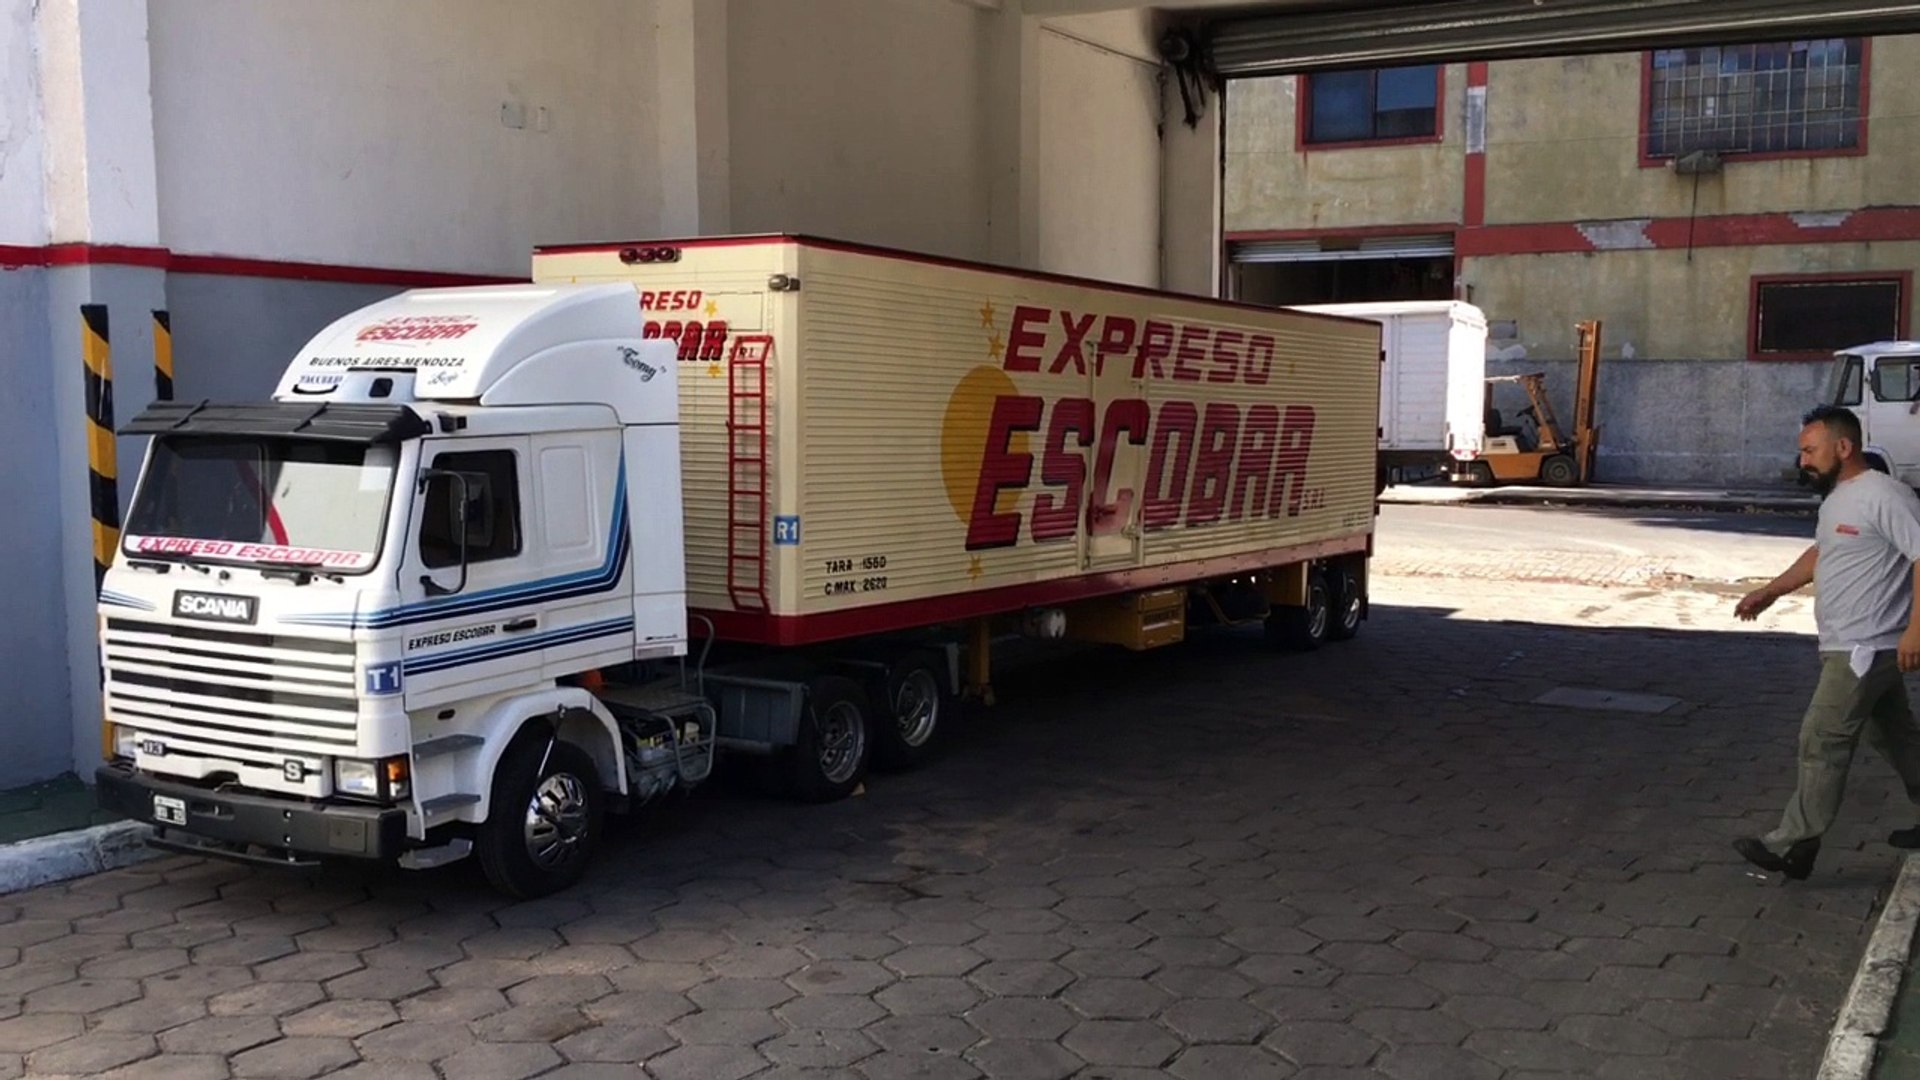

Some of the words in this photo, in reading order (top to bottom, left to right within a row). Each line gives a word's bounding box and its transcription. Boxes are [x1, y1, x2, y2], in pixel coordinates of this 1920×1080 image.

[356, 323, 478, 341] ESCOBAR
[1003, 304, 1275, 385] EXPRESO
[309, 356, 360, 367] BUENOS
[965, 394, 1315, 551] ESCOBAR
[777, 520, 798, 540] R1
[137, 536, 234, 555] EXPRESO
[236, 545, 362, 566] ESCOBAR
[825, 559, 853, 574] TARA
[178, 594, 249, 619] SCANIA
[408, 632, 452, 651] EXPRESO
[452, 624, 497, 642] ESCOBAR
[367, 665, 399, 690] T1
[284, 761, 301, 780] S
